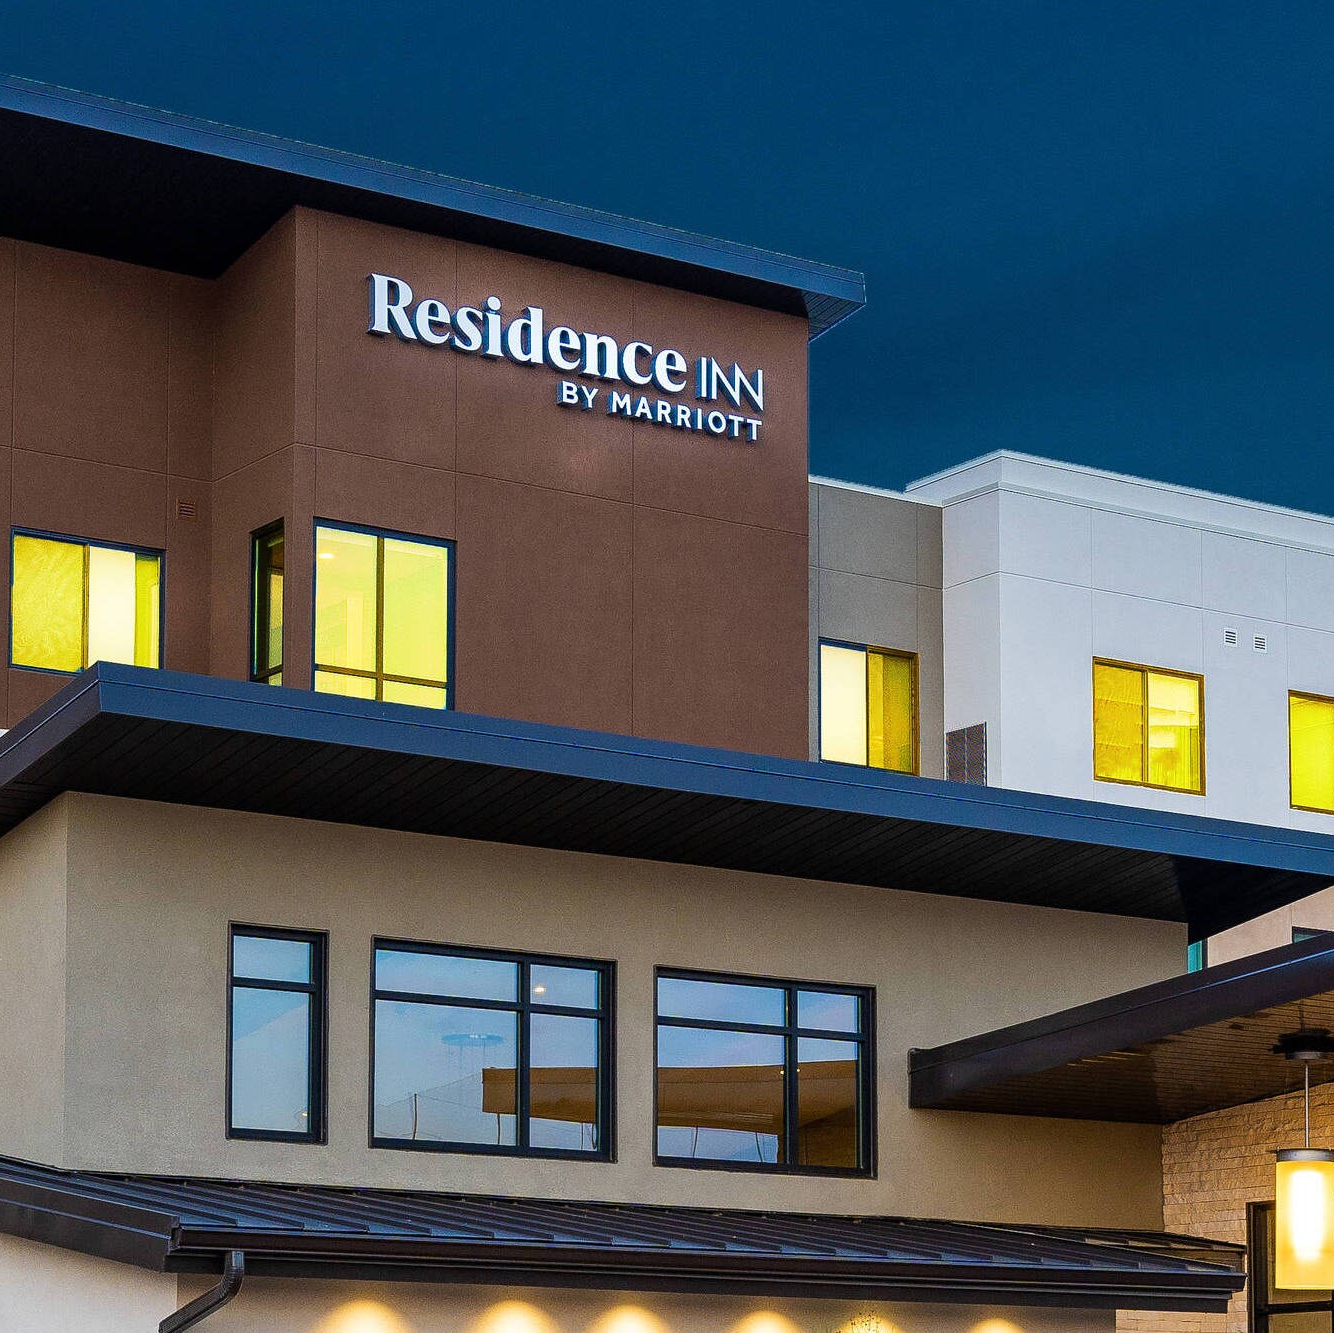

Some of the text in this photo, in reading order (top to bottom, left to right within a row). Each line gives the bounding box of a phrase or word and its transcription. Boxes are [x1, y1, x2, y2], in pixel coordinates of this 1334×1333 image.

[369, 273, 764, 411] Residence INN
[560, 381, 763, 441] BY MARRIOTT
